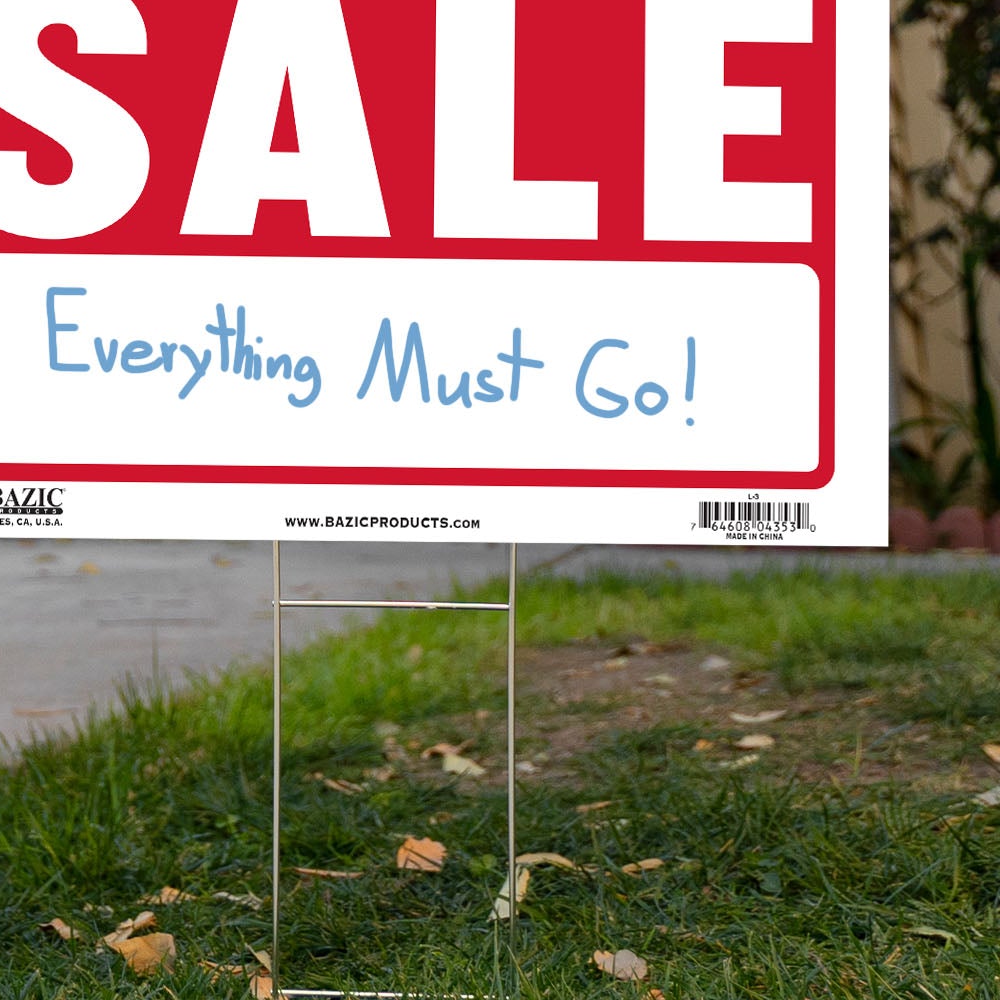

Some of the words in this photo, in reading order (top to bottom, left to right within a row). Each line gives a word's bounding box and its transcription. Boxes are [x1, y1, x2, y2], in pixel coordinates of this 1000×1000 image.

[46, 287, 323, 408] Everything
[357, 318, 545, 409] Must
[576, 336, 697, 427] Go!
[16, 518, 33, 527] CA,
[35, 518, 63, 526] U.S.A.
[759, 533, 784, 541] CHINA
